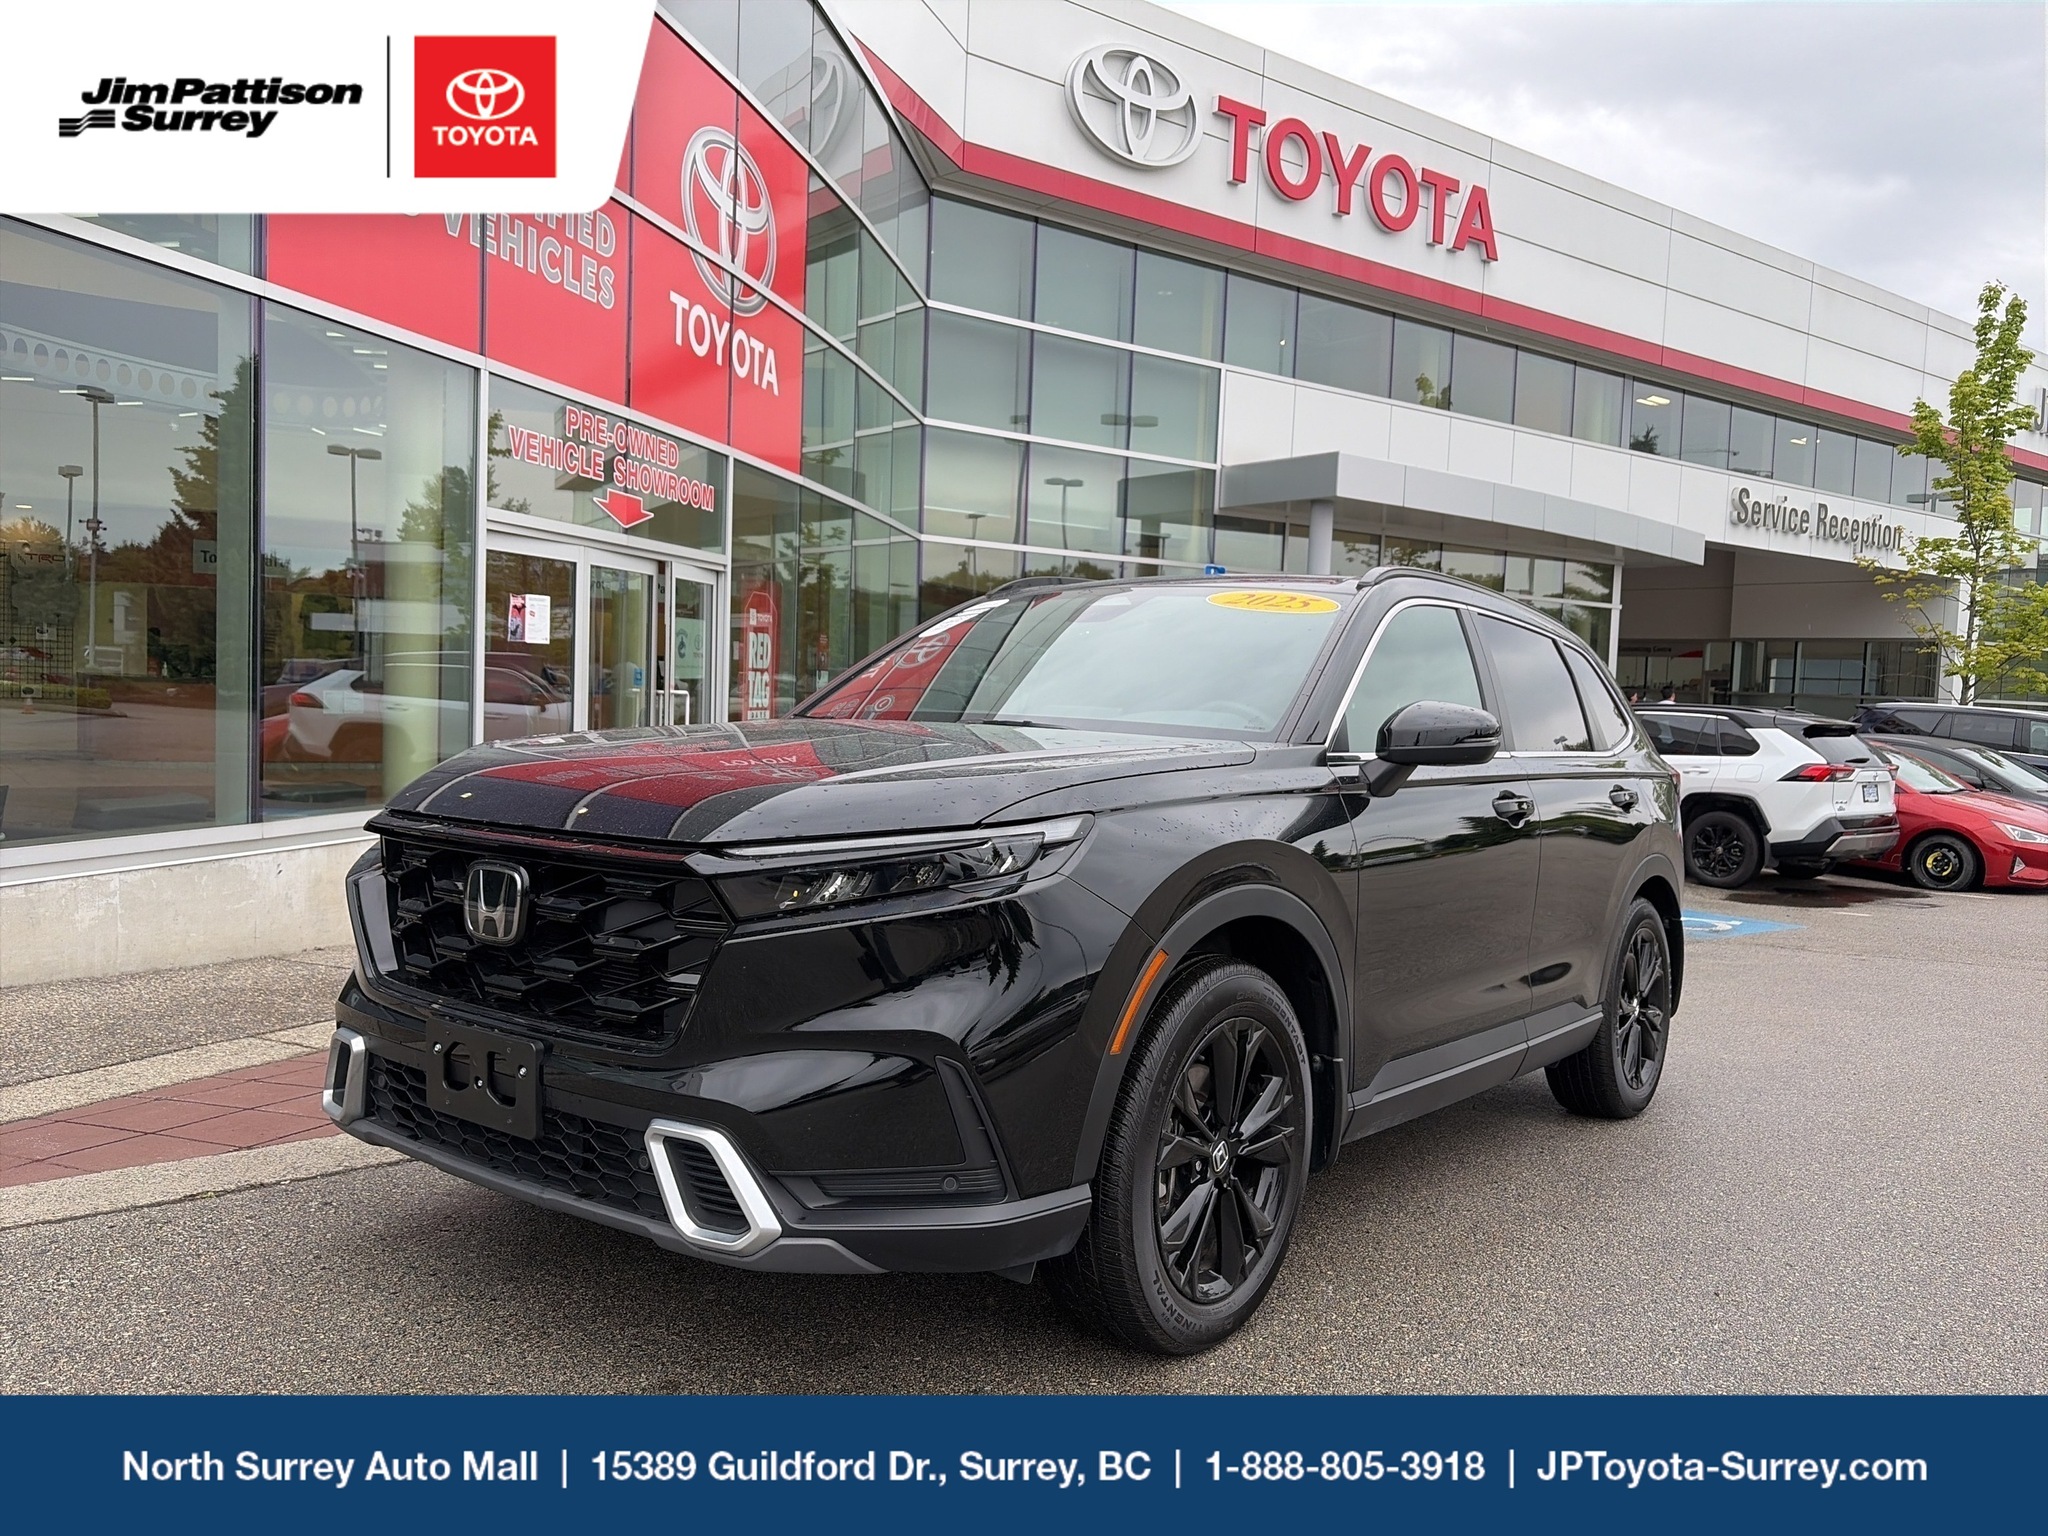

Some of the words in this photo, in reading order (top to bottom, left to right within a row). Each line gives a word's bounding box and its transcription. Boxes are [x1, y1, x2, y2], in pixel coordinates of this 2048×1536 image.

[1213, 94, 1498, 263] TOYOTA
[443, 212, 615, 310] VEHICLES
[669, 289, 779, 397] TOYOTA
[508, 425, 605, 482] VEHICLE
[613, 455, 715, 512] SHOWROOM
[565, 405, 680, 470] PRE-OWNED
[1731, 487, 1811, 535] Service
[1815, 502, 1903, 554] Reception
[1225, 593, 1322, 609] 2025
[748, 632, 772, 669] RED
[748, 670, 770, 708] TAG
